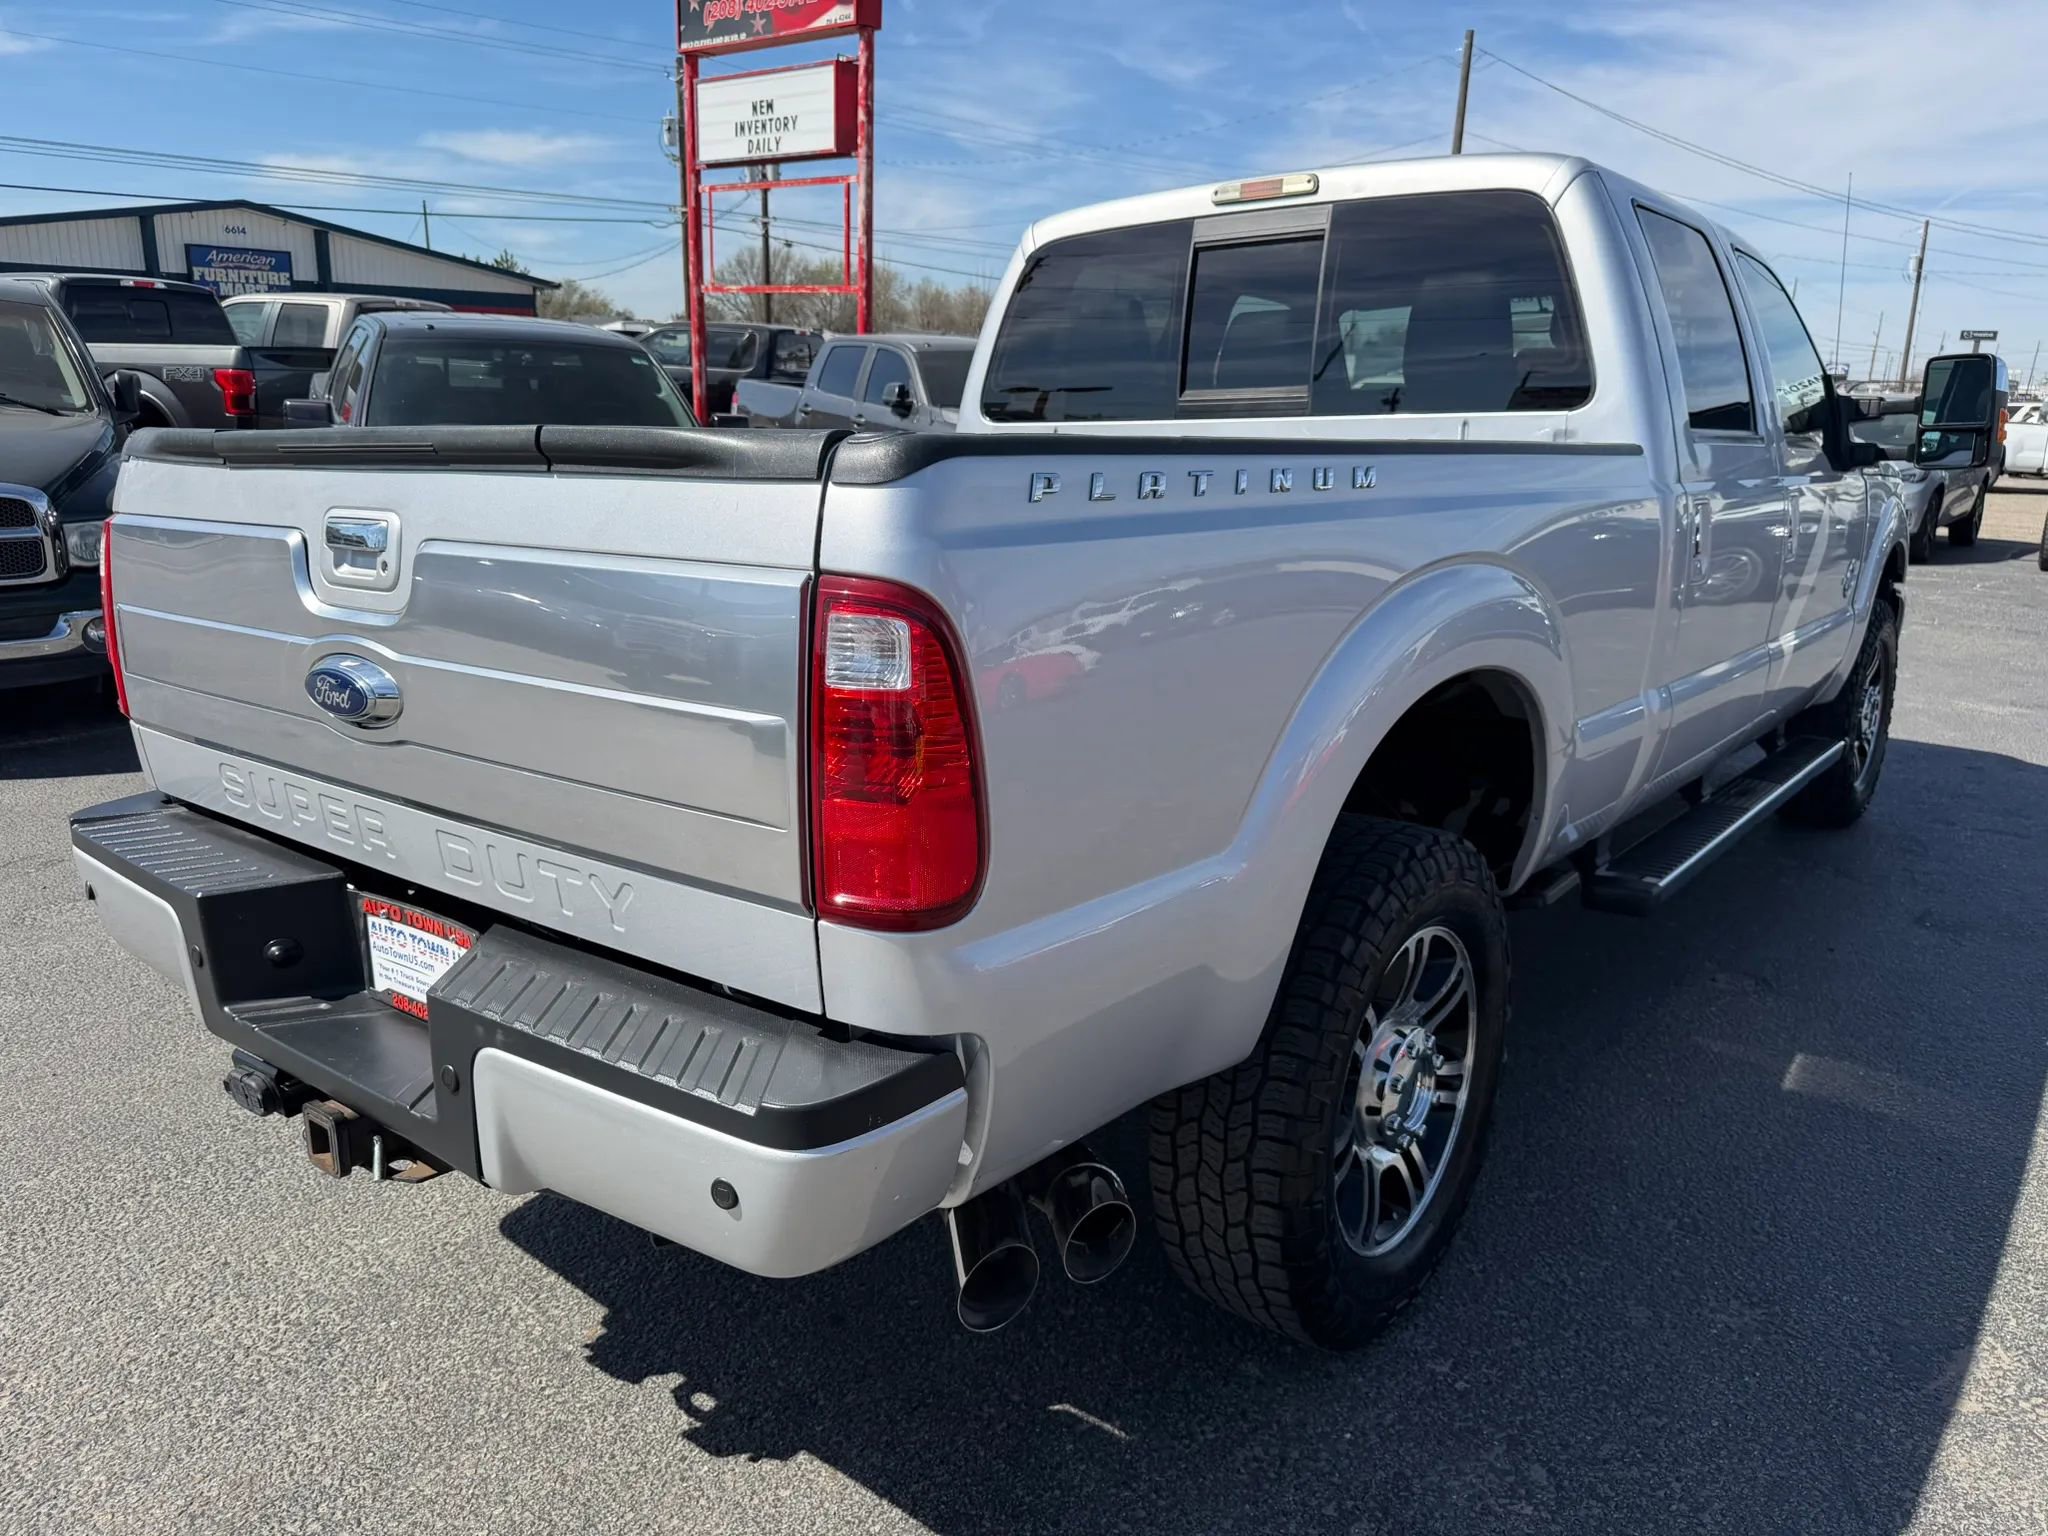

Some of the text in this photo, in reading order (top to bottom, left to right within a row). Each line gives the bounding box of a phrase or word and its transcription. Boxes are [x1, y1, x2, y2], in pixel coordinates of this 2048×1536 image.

[752, 99, 774, 116] NEW
[735, 115, 798, 137] INVENTORY
[748, 136, 781, 155] DAILY
[224, 225, 247, 235] 6614
[205, 250, 276, 266] American
[193, 267, 291, 286] FURNITURE
[219, 282, 269, 297] MART
[163, 366, 205, 382] FX4
[1029, 466, 1378, 503] PLATINUM
[314, 674, 352, 709] Ford
[218, 762, 636, 933] SUPER DUTY
[363, 898, 473, 949] AUTO TOWN USA
[370, 921, 408, 948] AUTO
[372, 941, 435, 973] AutoTownUS.com
